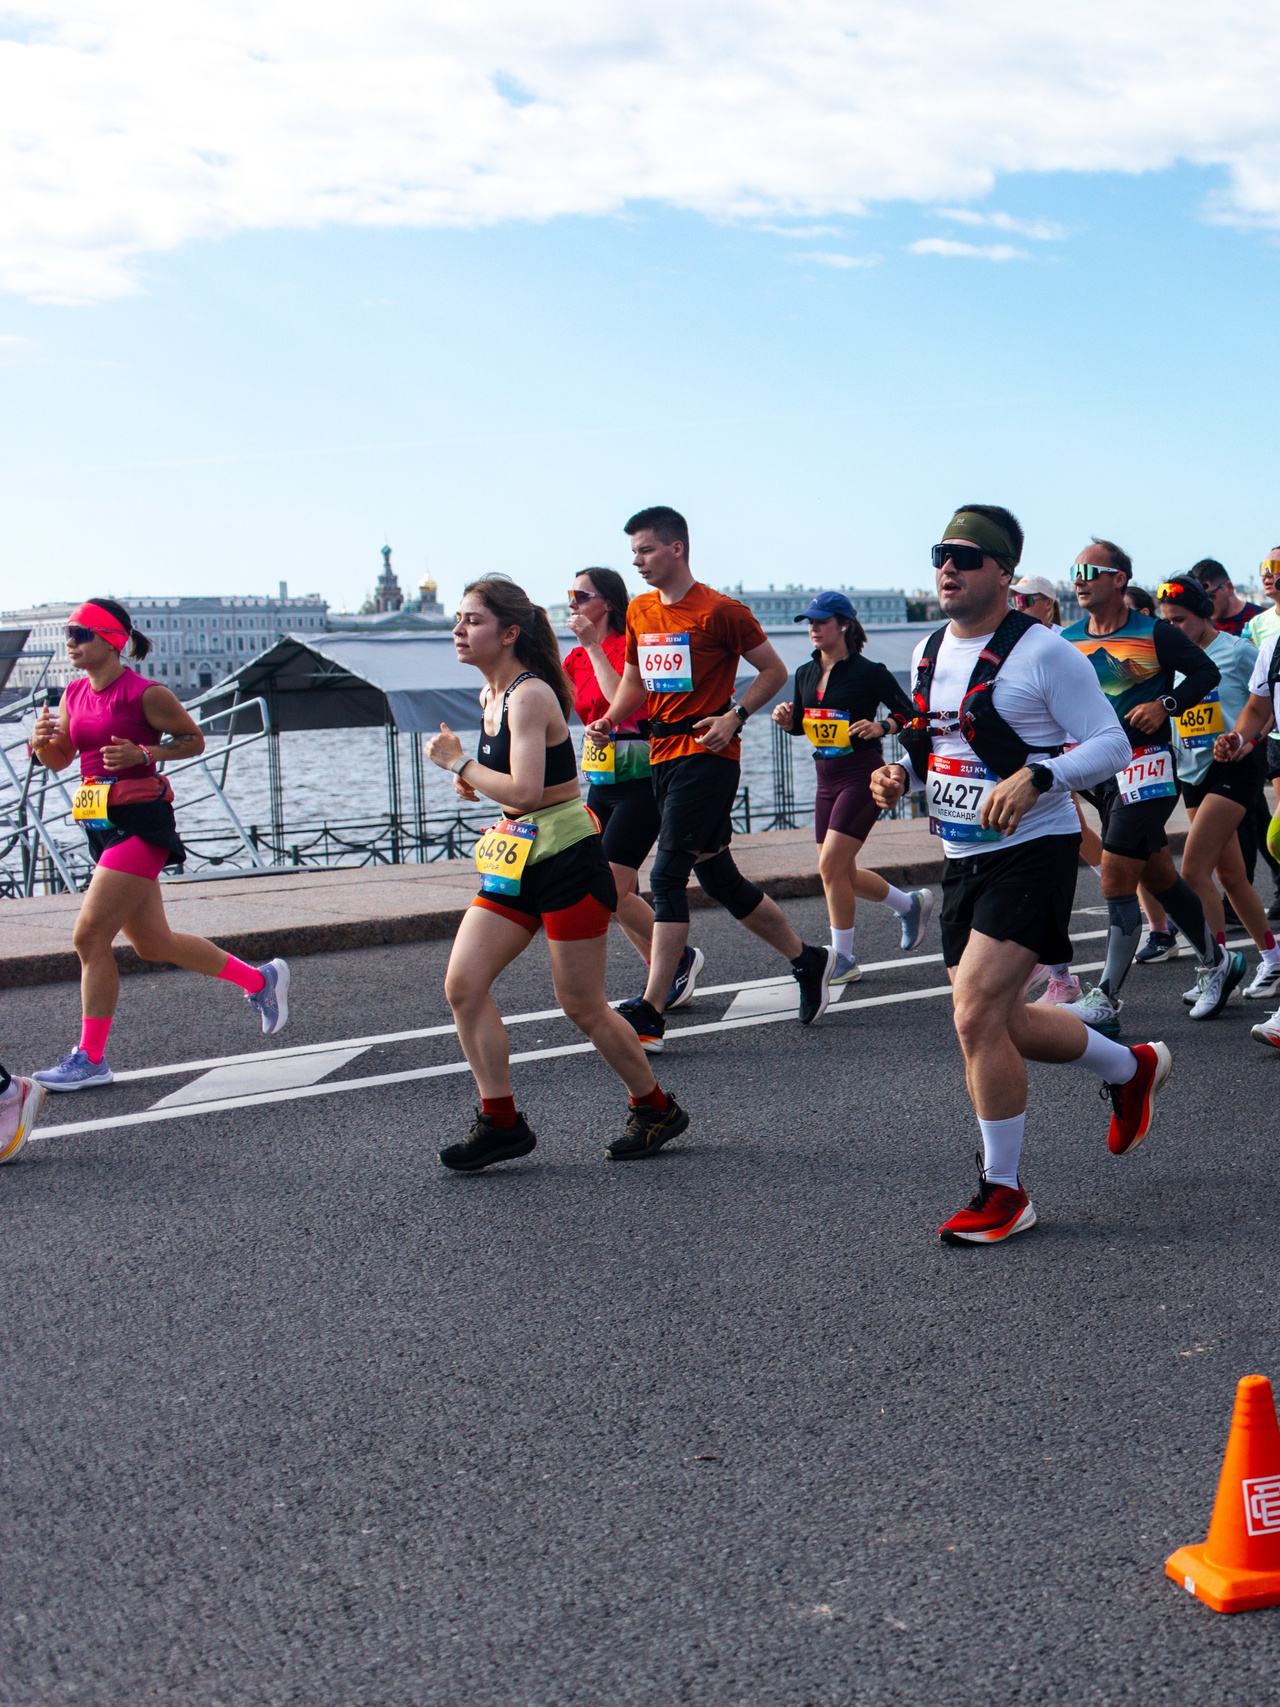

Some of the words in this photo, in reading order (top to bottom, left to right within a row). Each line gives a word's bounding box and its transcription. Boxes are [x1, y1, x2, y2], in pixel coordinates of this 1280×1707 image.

[645, 654, 683, 672] 6969
[1180, 706, 1214, 728] 4867
[812, 723, 838, 738] 137
[960, 764, 973, 774] 21,1
[1123, 758, 1165, 784] 7747
[932, 780, 984, 811] 2427
[1130, 790, 1138, 800] E
[938, 808, 976, 821] АЛЕКСАНДР
[516, 826, 528, 834] КМ
[478, 838, 518, 864] 6496
